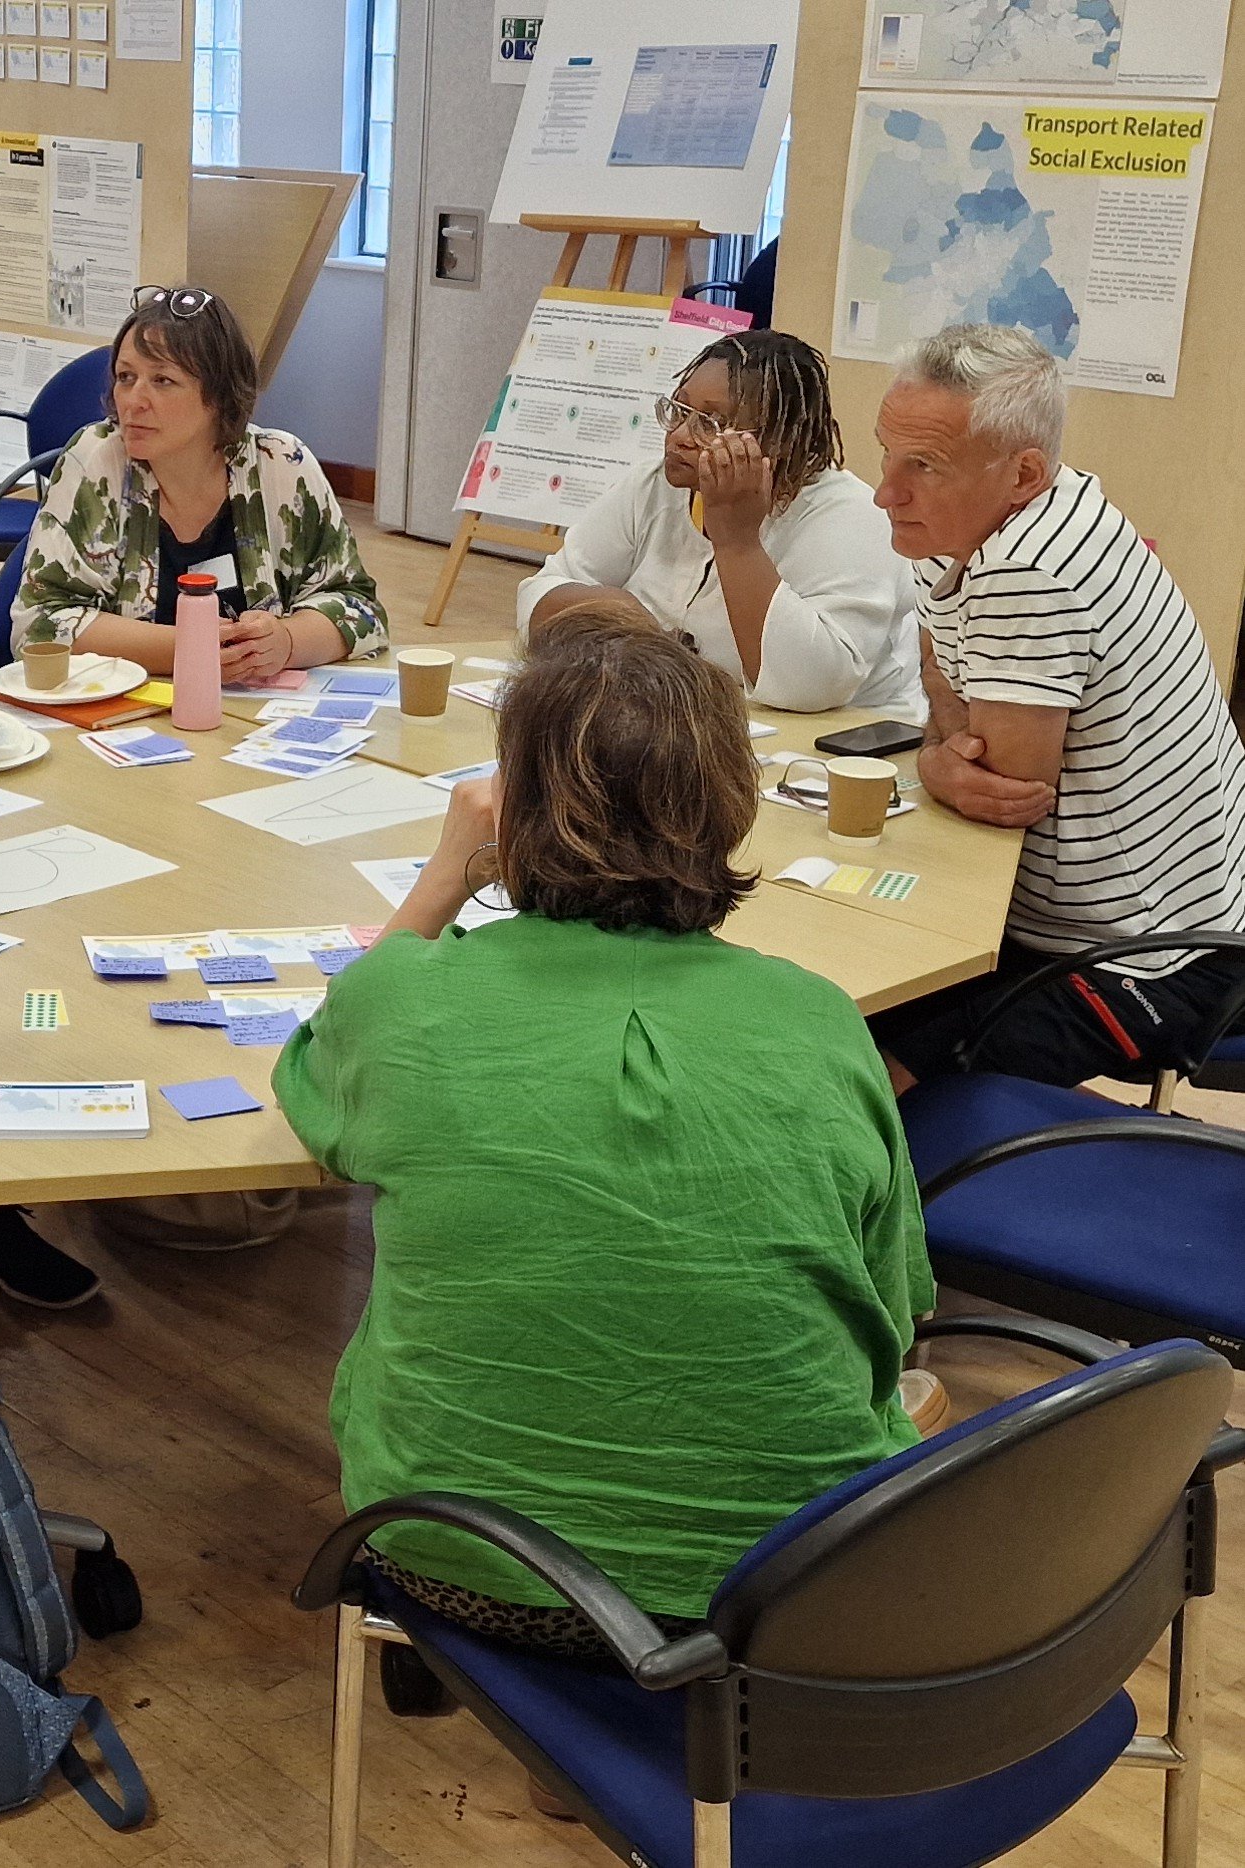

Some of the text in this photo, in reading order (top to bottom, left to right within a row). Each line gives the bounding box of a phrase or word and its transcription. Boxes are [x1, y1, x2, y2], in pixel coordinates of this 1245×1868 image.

[1025, 112, 1203, 139] Transport Related
[1029, 146, 1186, 173] Social Exclusion
[674, 310, 709, 324] Sheffield
[589, 340, 594, 350] 2
[649, 346, 656, 356] 3
[511, 399, 517, 407] 4
[570, 407, 576, 416] 5
[632, 415, 638, 425] 6
[552, 477, 558, 486] 8
[1130, 986, 1163, 1026] MONTANE
